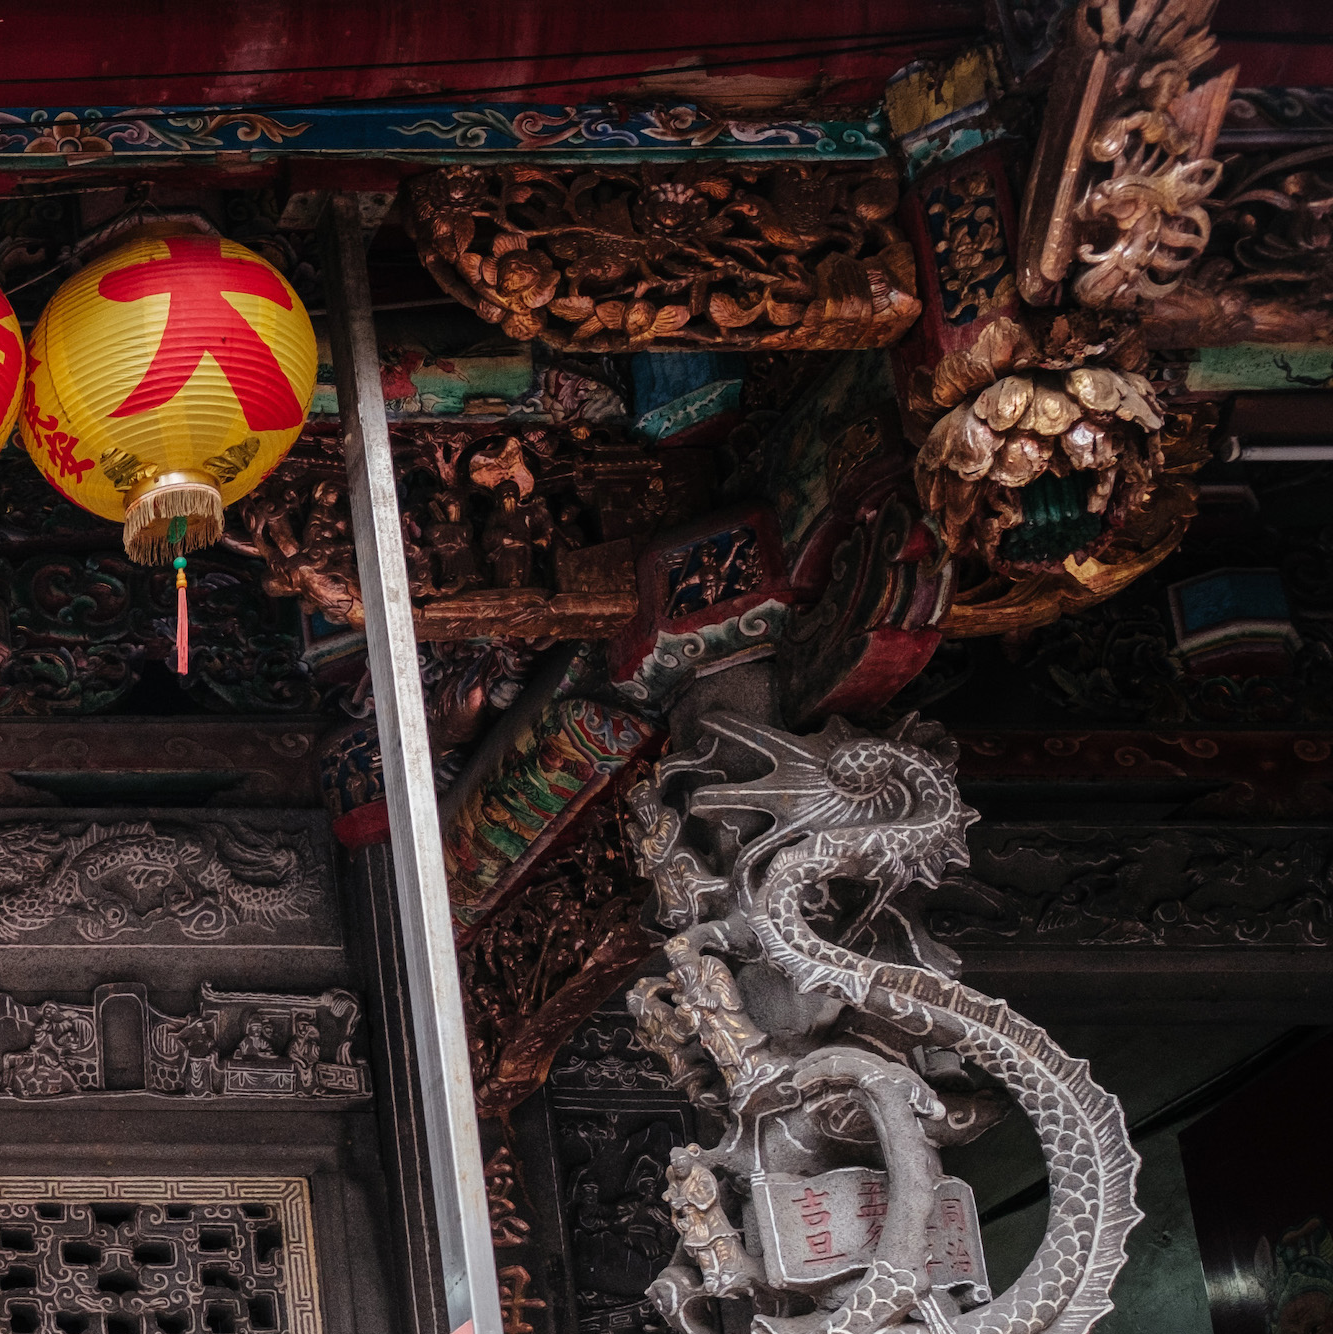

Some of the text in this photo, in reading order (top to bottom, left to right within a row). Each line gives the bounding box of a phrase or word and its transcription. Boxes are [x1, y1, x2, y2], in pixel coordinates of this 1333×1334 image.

[97, 236, 303, 432] 大
[790, 1187, 848, 1264] 吉旦
[939, 1198, 973, 1274] 同治
